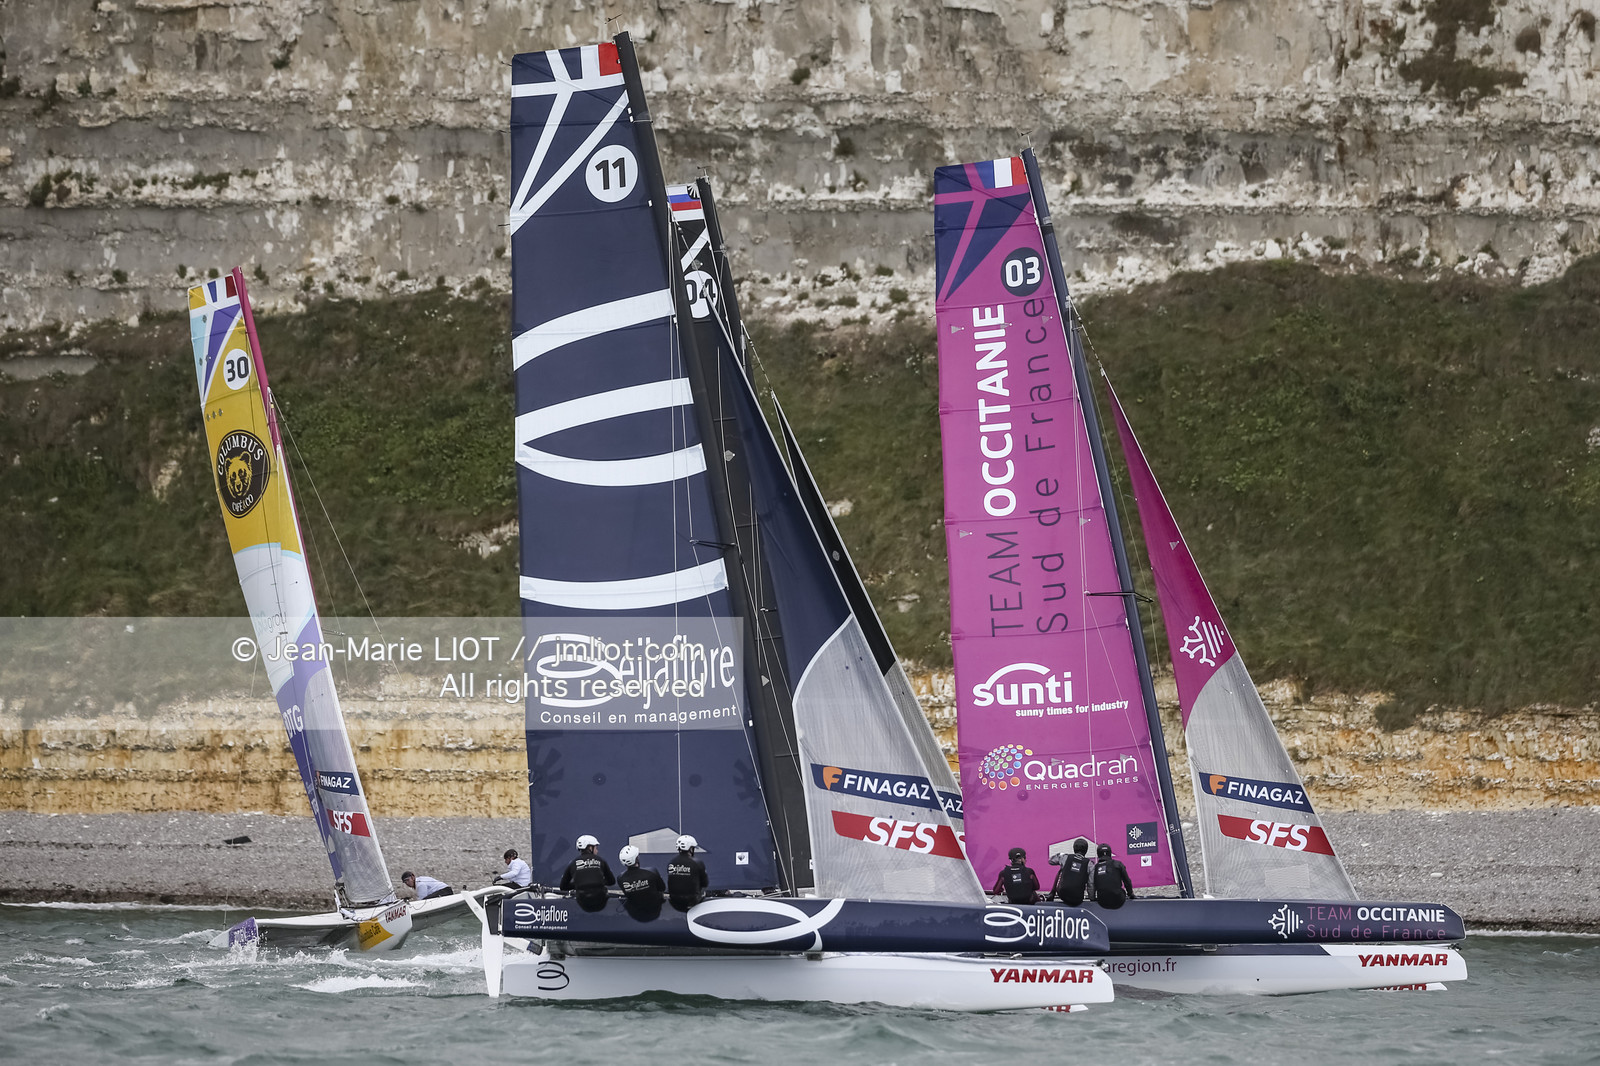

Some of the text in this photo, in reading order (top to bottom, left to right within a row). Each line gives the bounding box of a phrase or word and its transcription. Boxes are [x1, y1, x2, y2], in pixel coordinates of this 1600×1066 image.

[595, 157, 626, 190] 11
[1005, 256, 1041, 287] 03
[226, 356, 249, 382] 30
[218, 435, 263, 475] COLUMBUS
[1025, 298, 1069, 633] Sud de France
[972, 304, 1024, 637] TEAM OCCITANIE
[536, 632, 736, 709] Beijaflore
[972, 662, 1073, 706] sunti
[540, 705, 737, 724] Conseil en management
[1015, 700, 1129, 718] sunny times for industry
[1023, 755, 1138, 781] Quadran
[843, 773, 932, 801] FINAGAZ
[1026, 776, 1139, 790] ENERGIES LIBRES
[1226, 782, 1304, 804] FINAGAZ
[332, 810, 354, 835] SFS
[862, 816, 938, 854] SFS
[1244, 820, 1312, 850] SFS
[514, 902, 568, 926] Beijaflore
[983, 905, 1090, 945] Beijaflore
[1307, 906, 1446, 922] TEAM OCCITANIE
[1307, 924, 1446, 940] Sud de France
[1357, 953, 1448, 967] YANMAR
[990, 968, 1094, 983] YANMAR
